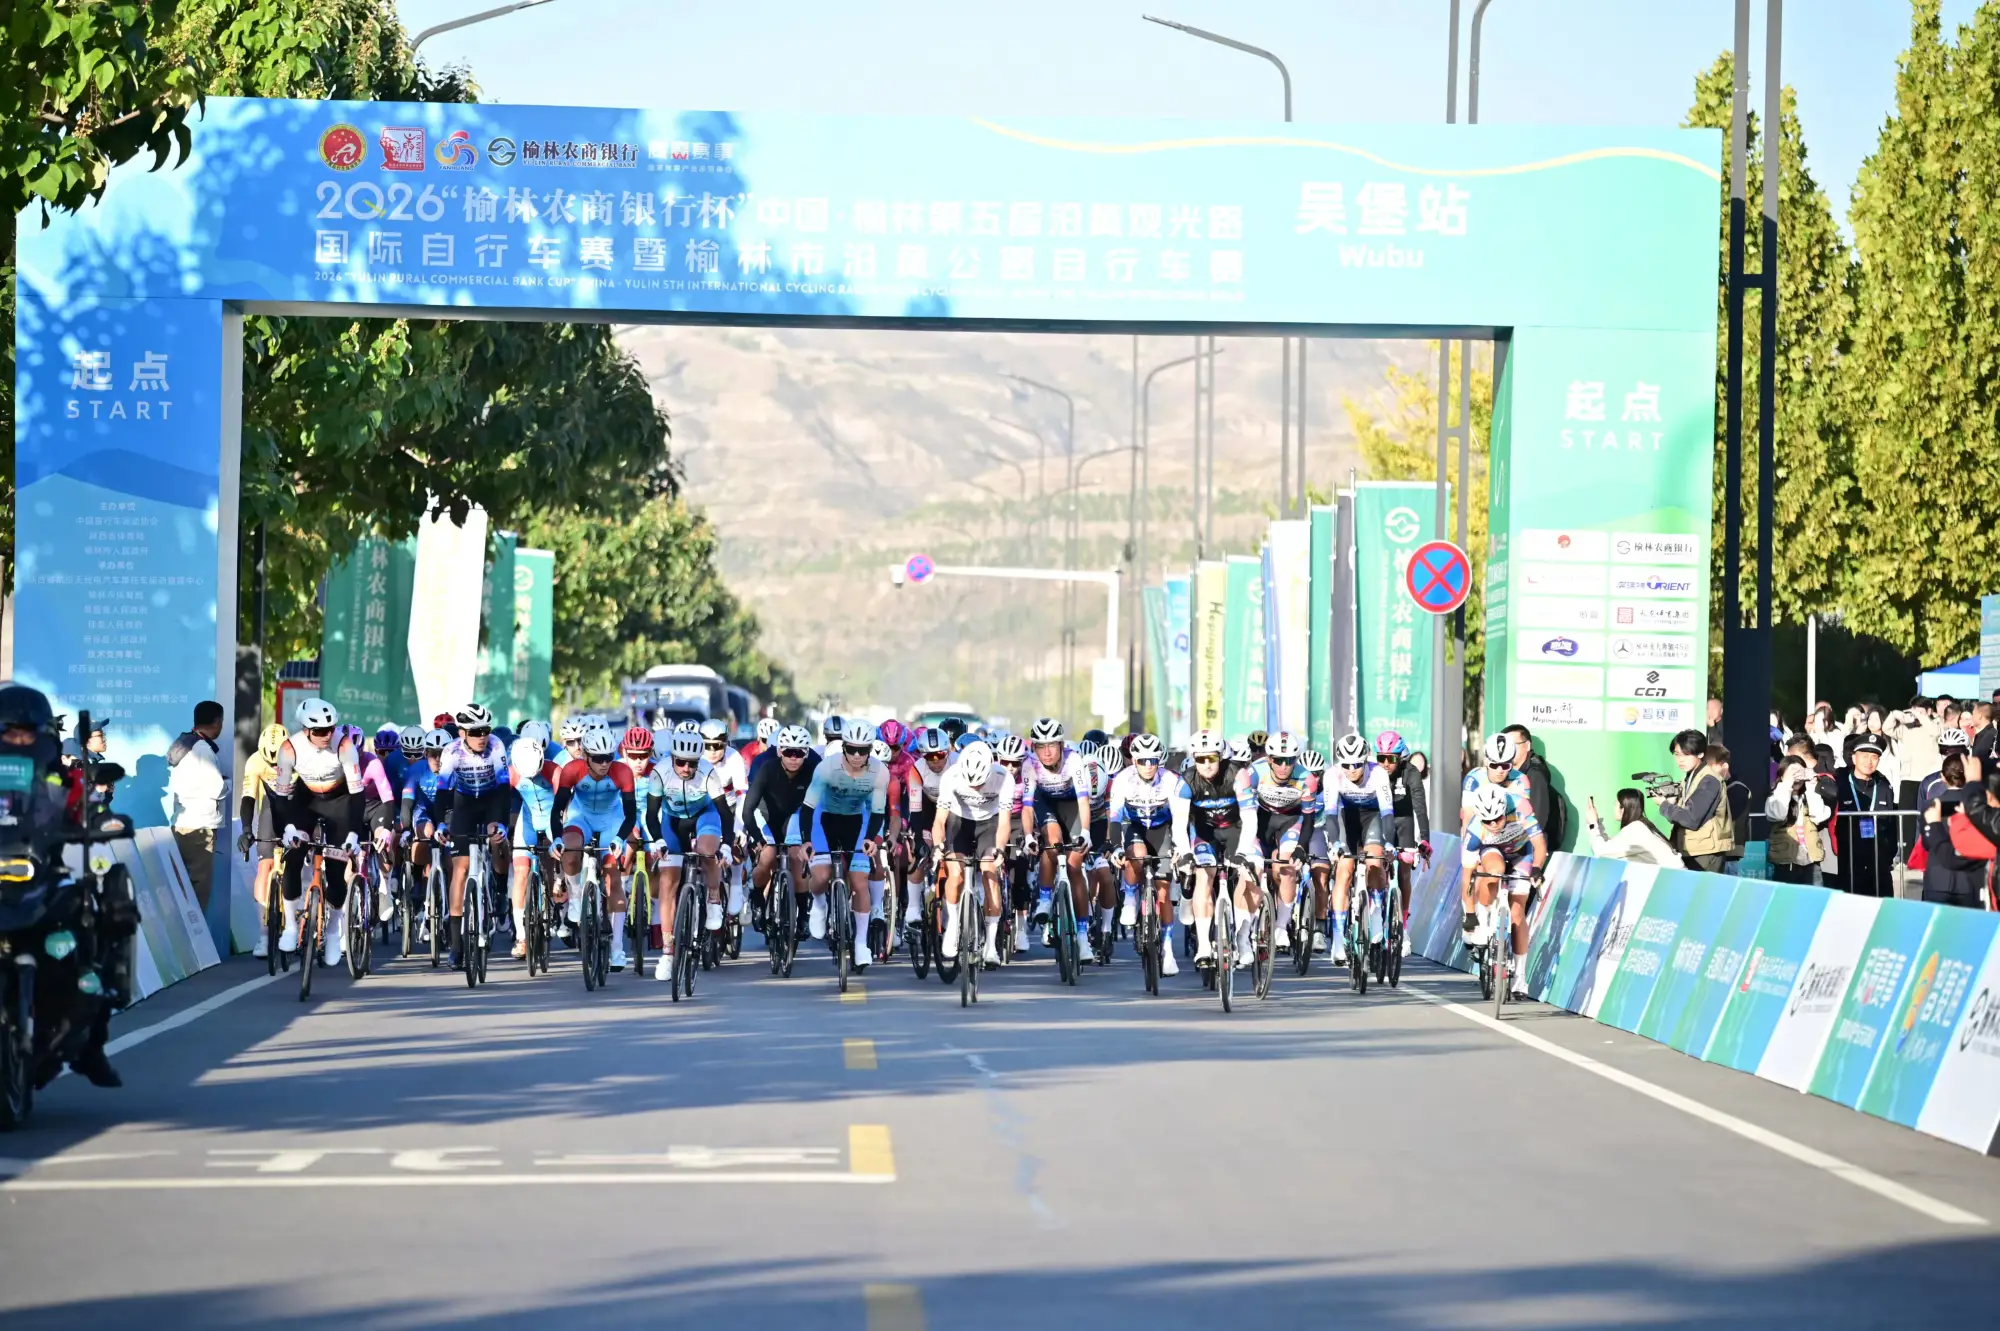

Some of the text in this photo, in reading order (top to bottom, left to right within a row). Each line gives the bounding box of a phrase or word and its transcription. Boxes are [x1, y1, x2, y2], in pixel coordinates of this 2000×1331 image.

[522, 140, 640, 162] 榆林农商银行
[1293, 181, 1472, 236] 吴堡站
[1338, 243, 1425, 269] Wubu
[314, 271, 342, 282] 2026
[389, 273, 427, 284] RURAL
[430, 274, 508, 286] COMMERCIAL
[512, 276, 544, 287] BANK
[625, 279, 659, 290] YULIN
[688, 280, 782, 292] INTERNATIONAL
[786, 283, 835, 294] CYCLING
[71, 350, 170, 393] 起点
[67, 399, 173, 421] START
[1564, 380, 1662, 423] 起点
[1560, 428, 1665, 451] START
[1634, 540, 1693, 554] 榆林农商银行
[1642, 707, 1679, 721] 智赛通
